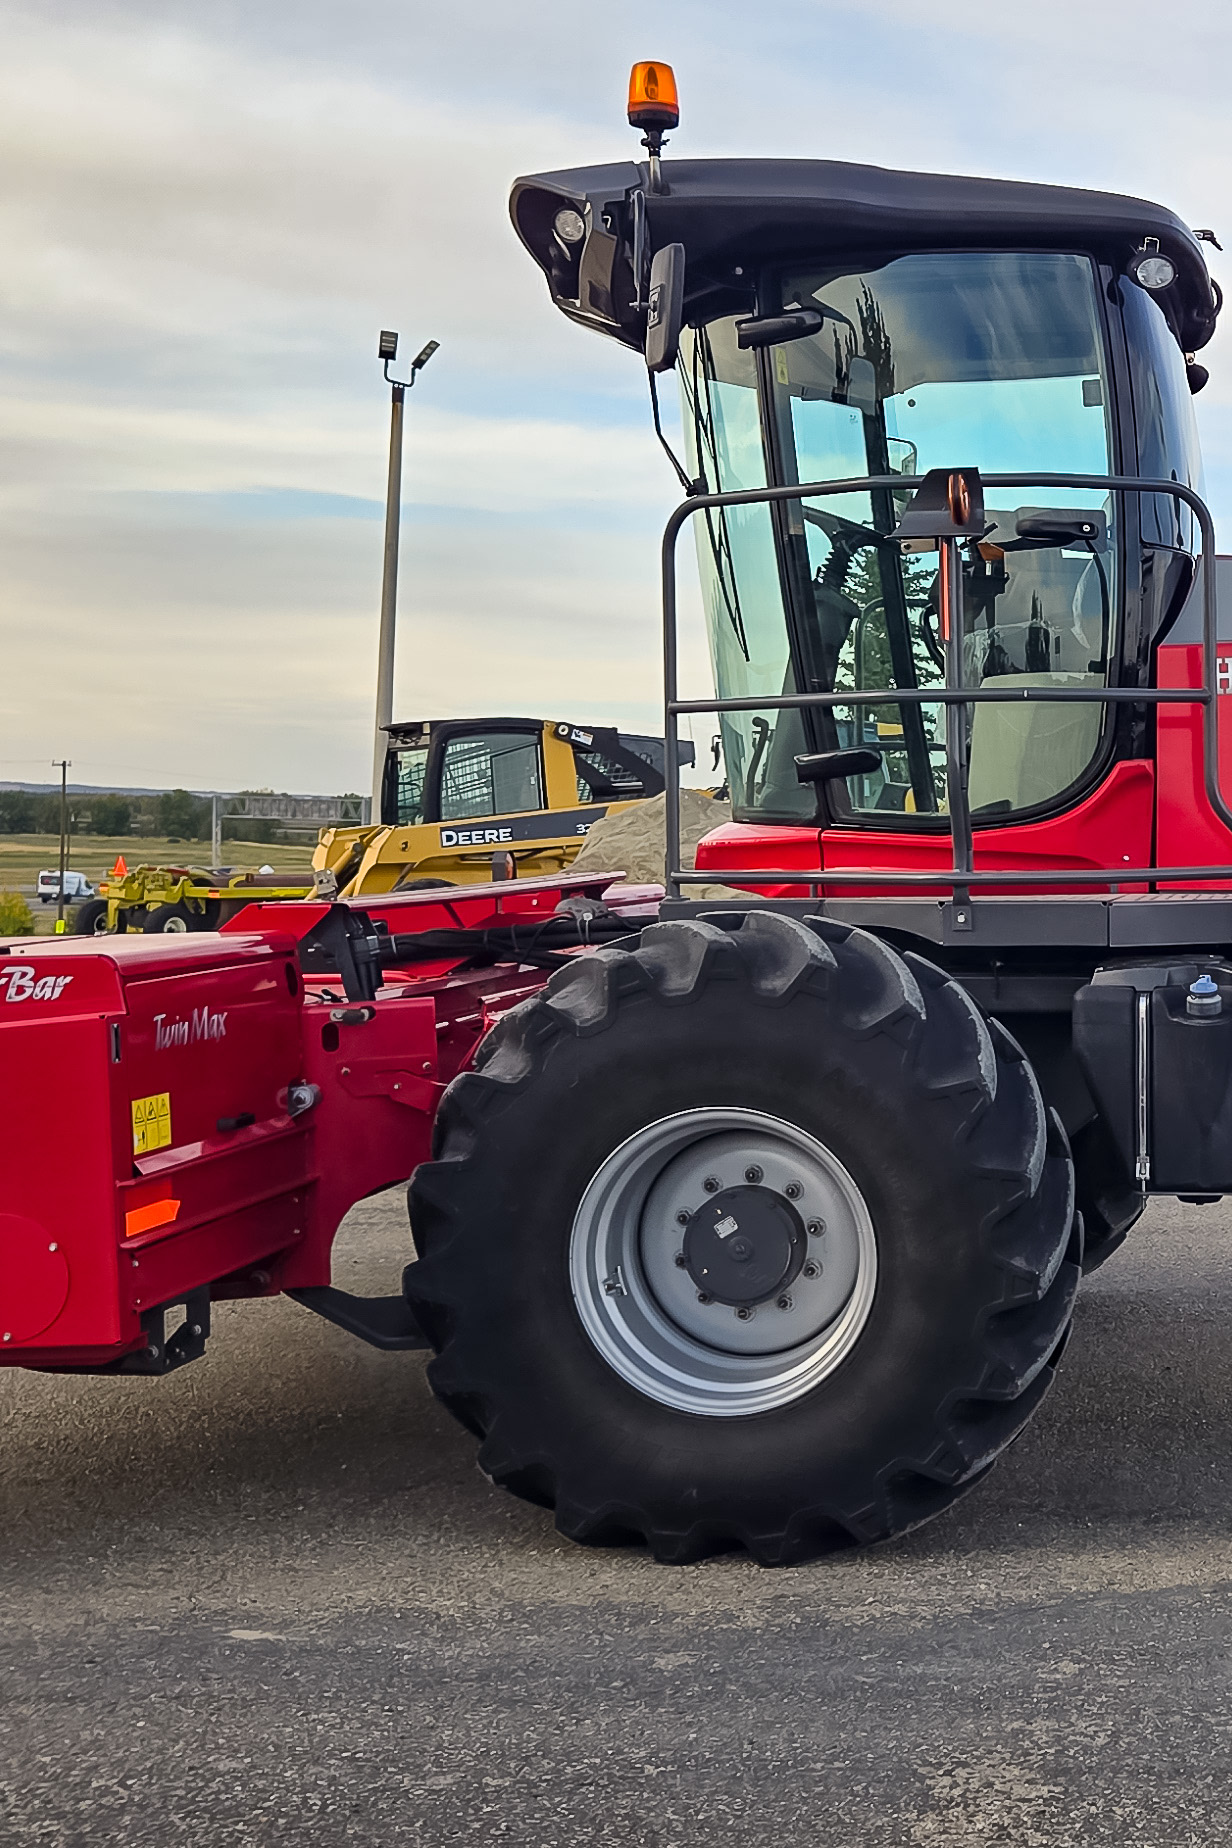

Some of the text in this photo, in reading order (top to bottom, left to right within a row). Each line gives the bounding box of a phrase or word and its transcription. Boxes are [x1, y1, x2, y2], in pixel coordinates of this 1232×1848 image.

[441, 828, 512, 847] DEERE
[153, 1005, 228, 1051] Twin Max
